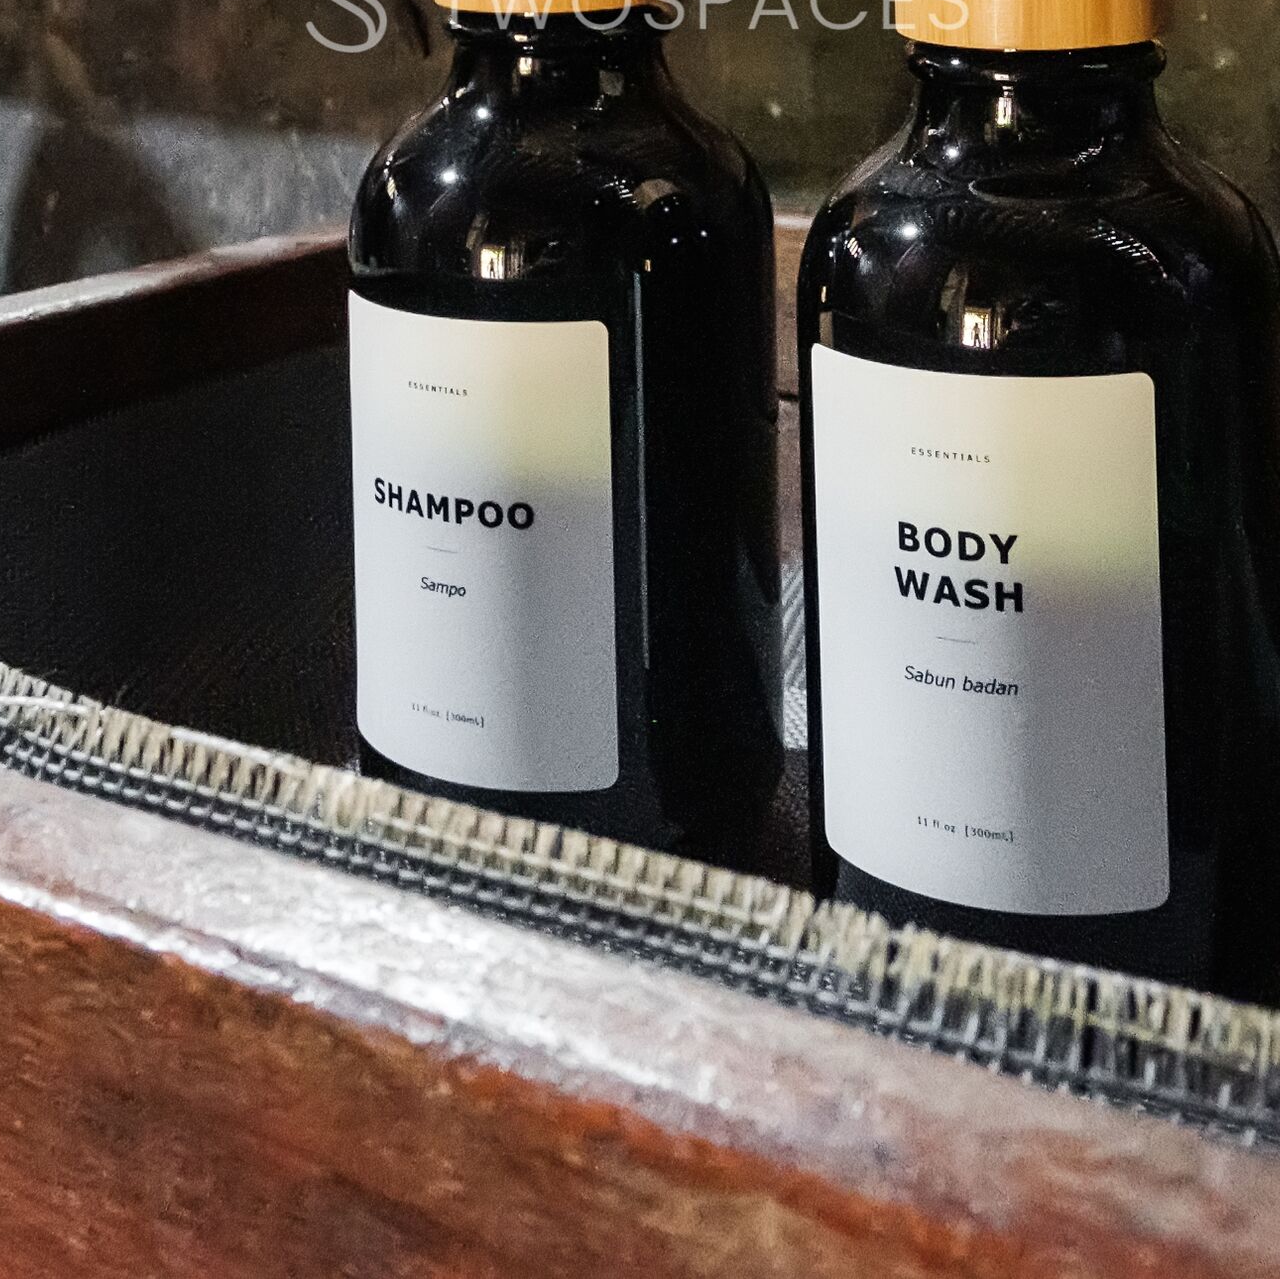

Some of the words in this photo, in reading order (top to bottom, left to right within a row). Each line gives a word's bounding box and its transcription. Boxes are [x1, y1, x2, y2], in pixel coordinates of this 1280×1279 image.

[408, 380, 468, 397] ESSENTIALS
[911, 446, 991, 464] ESSENTIALS
[374, 476, 535, 530] SHAMPOO
[898, 521, 1018, 565] BODY
[420, 576, 467, 598] Sampo
[894, 566, 1024, 614] WASH
[904, 665, 956, 690] Sabun
[962, 675, 1019, 696] badan
[917, 815, 928, 827] 11
